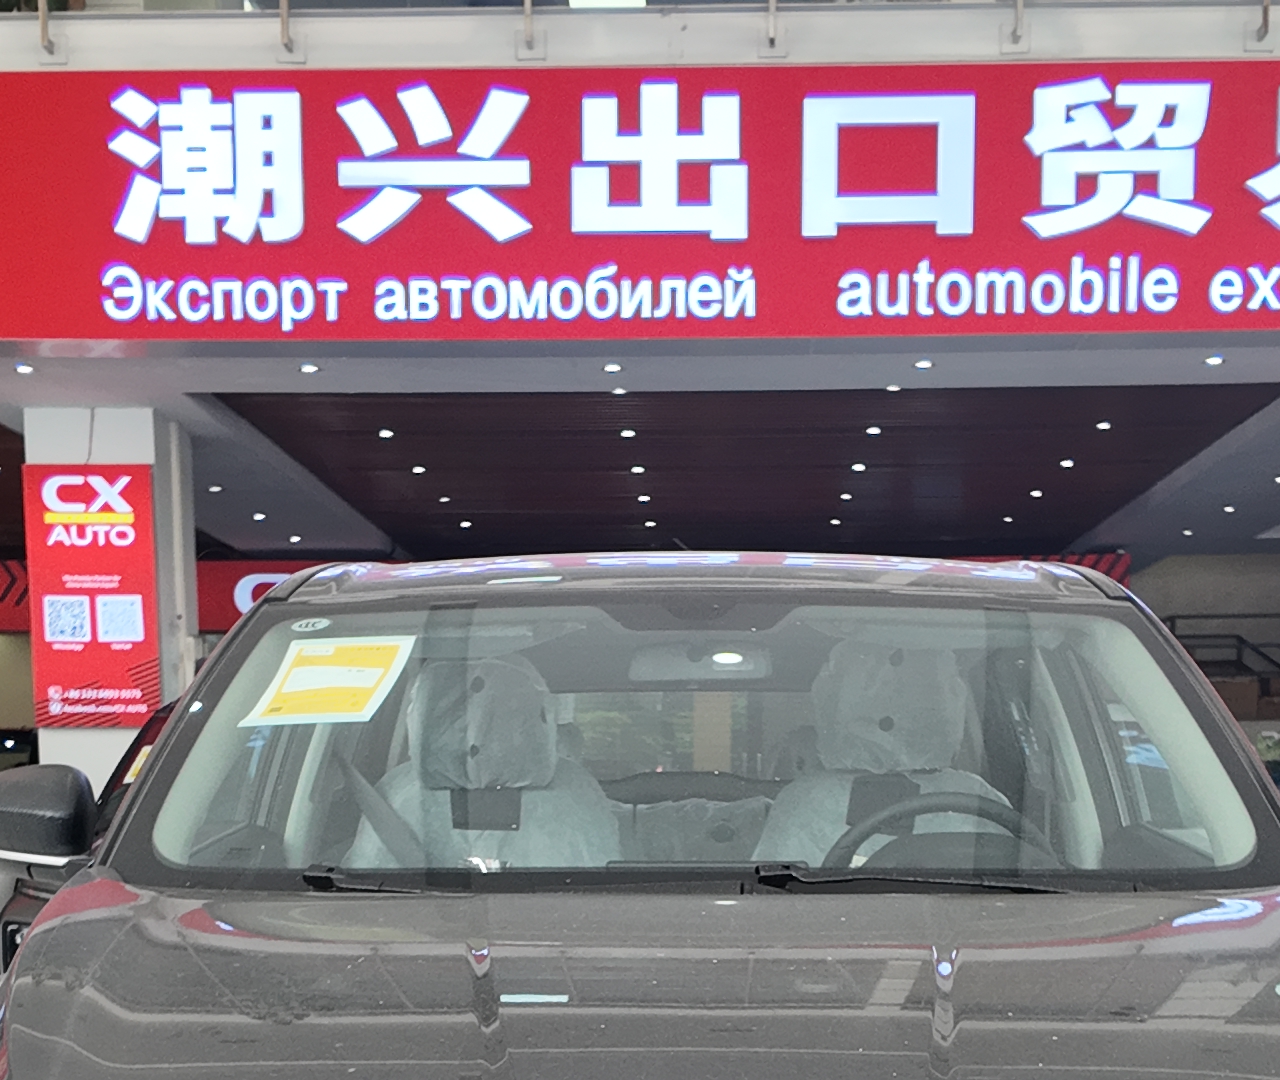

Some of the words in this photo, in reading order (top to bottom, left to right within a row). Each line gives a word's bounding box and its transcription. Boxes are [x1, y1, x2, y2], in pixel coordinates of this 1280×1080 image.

[101, 266, 348, 332] Экспорт
[374, 265, 756, 321] автомобилей
[836, 255, 1179, 317] automobile
[41, 475, 133, 512] CX
[46, 525, 136, 547] AUTO
